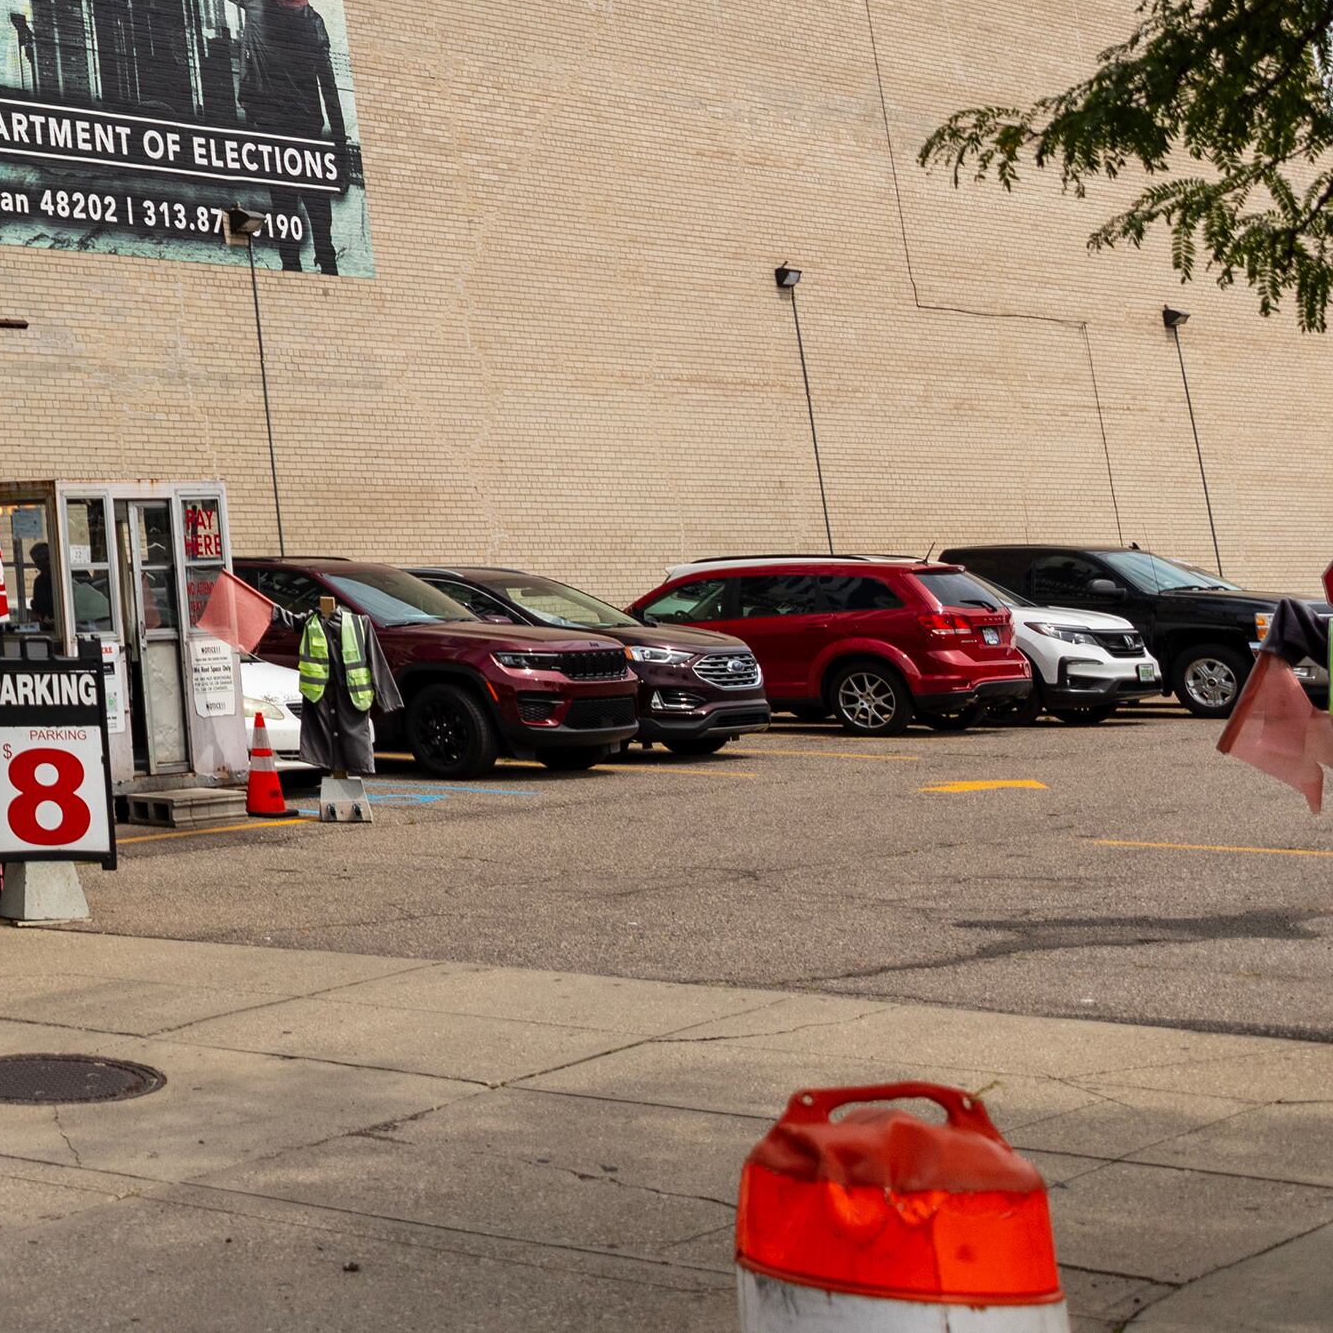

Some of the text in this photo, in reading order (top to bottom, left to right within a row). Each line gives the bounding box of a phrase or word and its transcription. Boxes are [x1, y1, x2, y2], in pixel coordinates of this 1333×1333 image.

[142, 130, 181, 162] OF
[192, 136, 339, 181] ELECTIONS
[40, 188, 118, 223] 48202
[185, 509, 214, 531] PAY
[184, 534, 223, 556] HERE
[29, 729, 87, 741] PARKING
